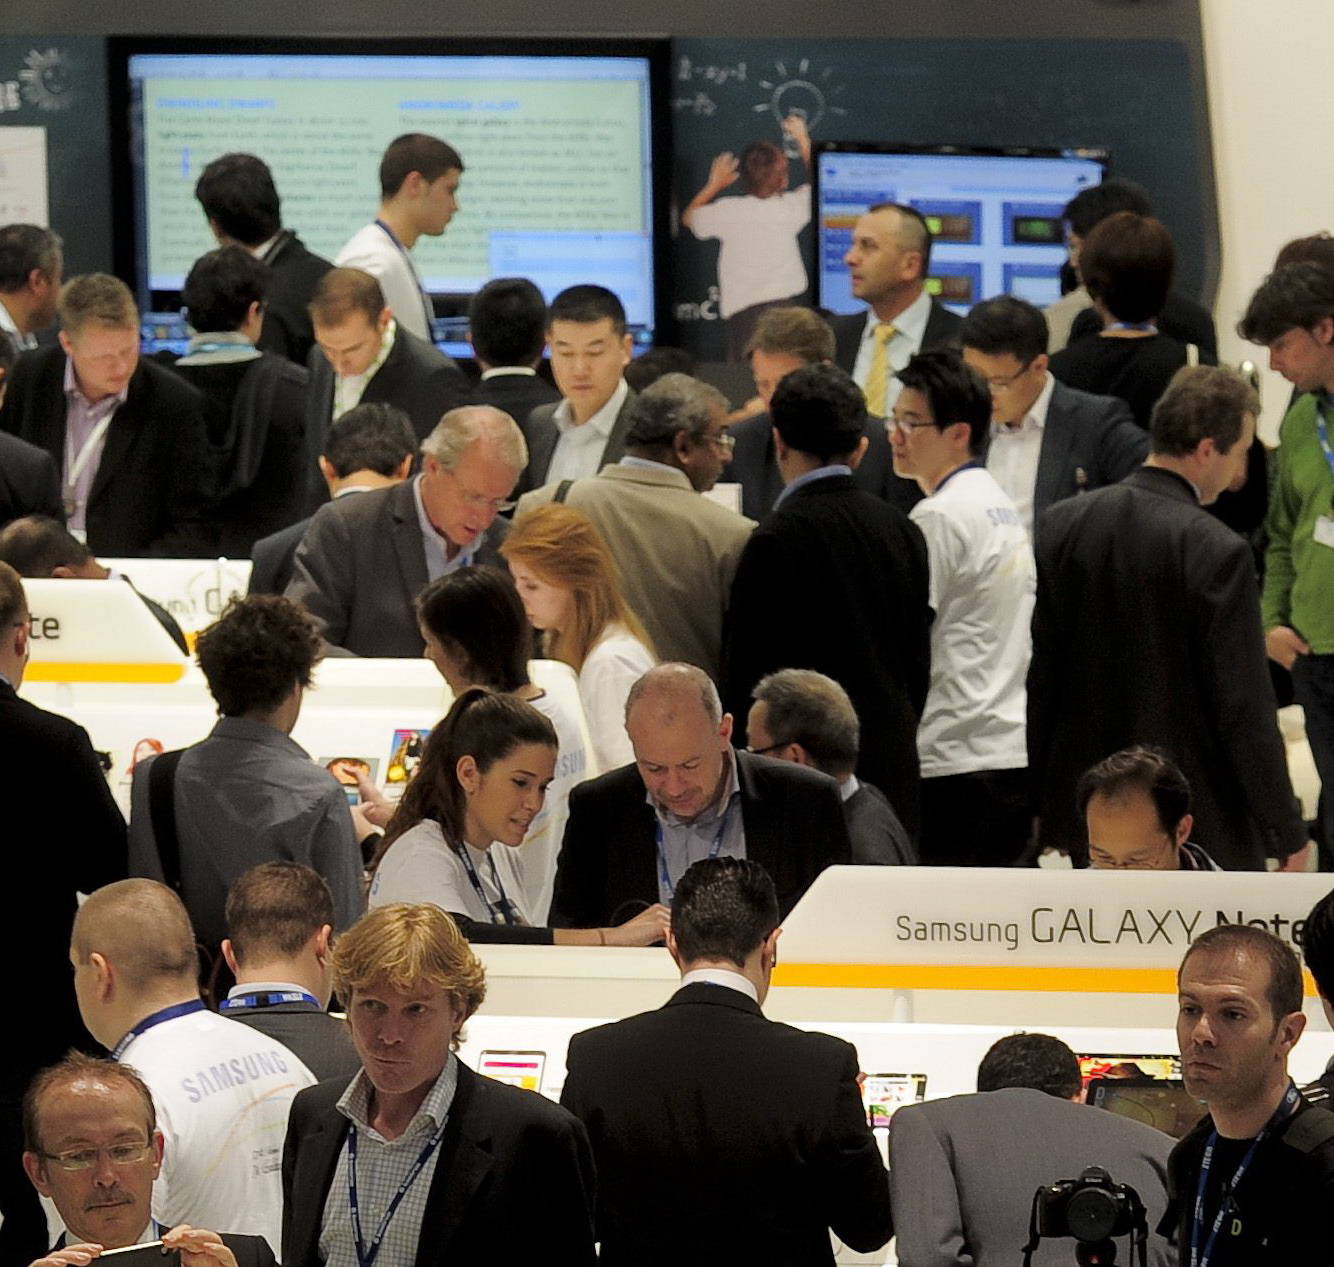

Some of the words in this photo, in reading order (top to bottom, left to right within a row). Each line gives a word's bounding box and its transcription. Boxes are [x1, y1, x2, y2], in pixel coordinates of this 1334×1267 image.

[895, 915, 1019, 951] Samsung
[1030, 907, 1202, 945] GALAXY
[181, 1051, 288, 1103] SAMSUNG
